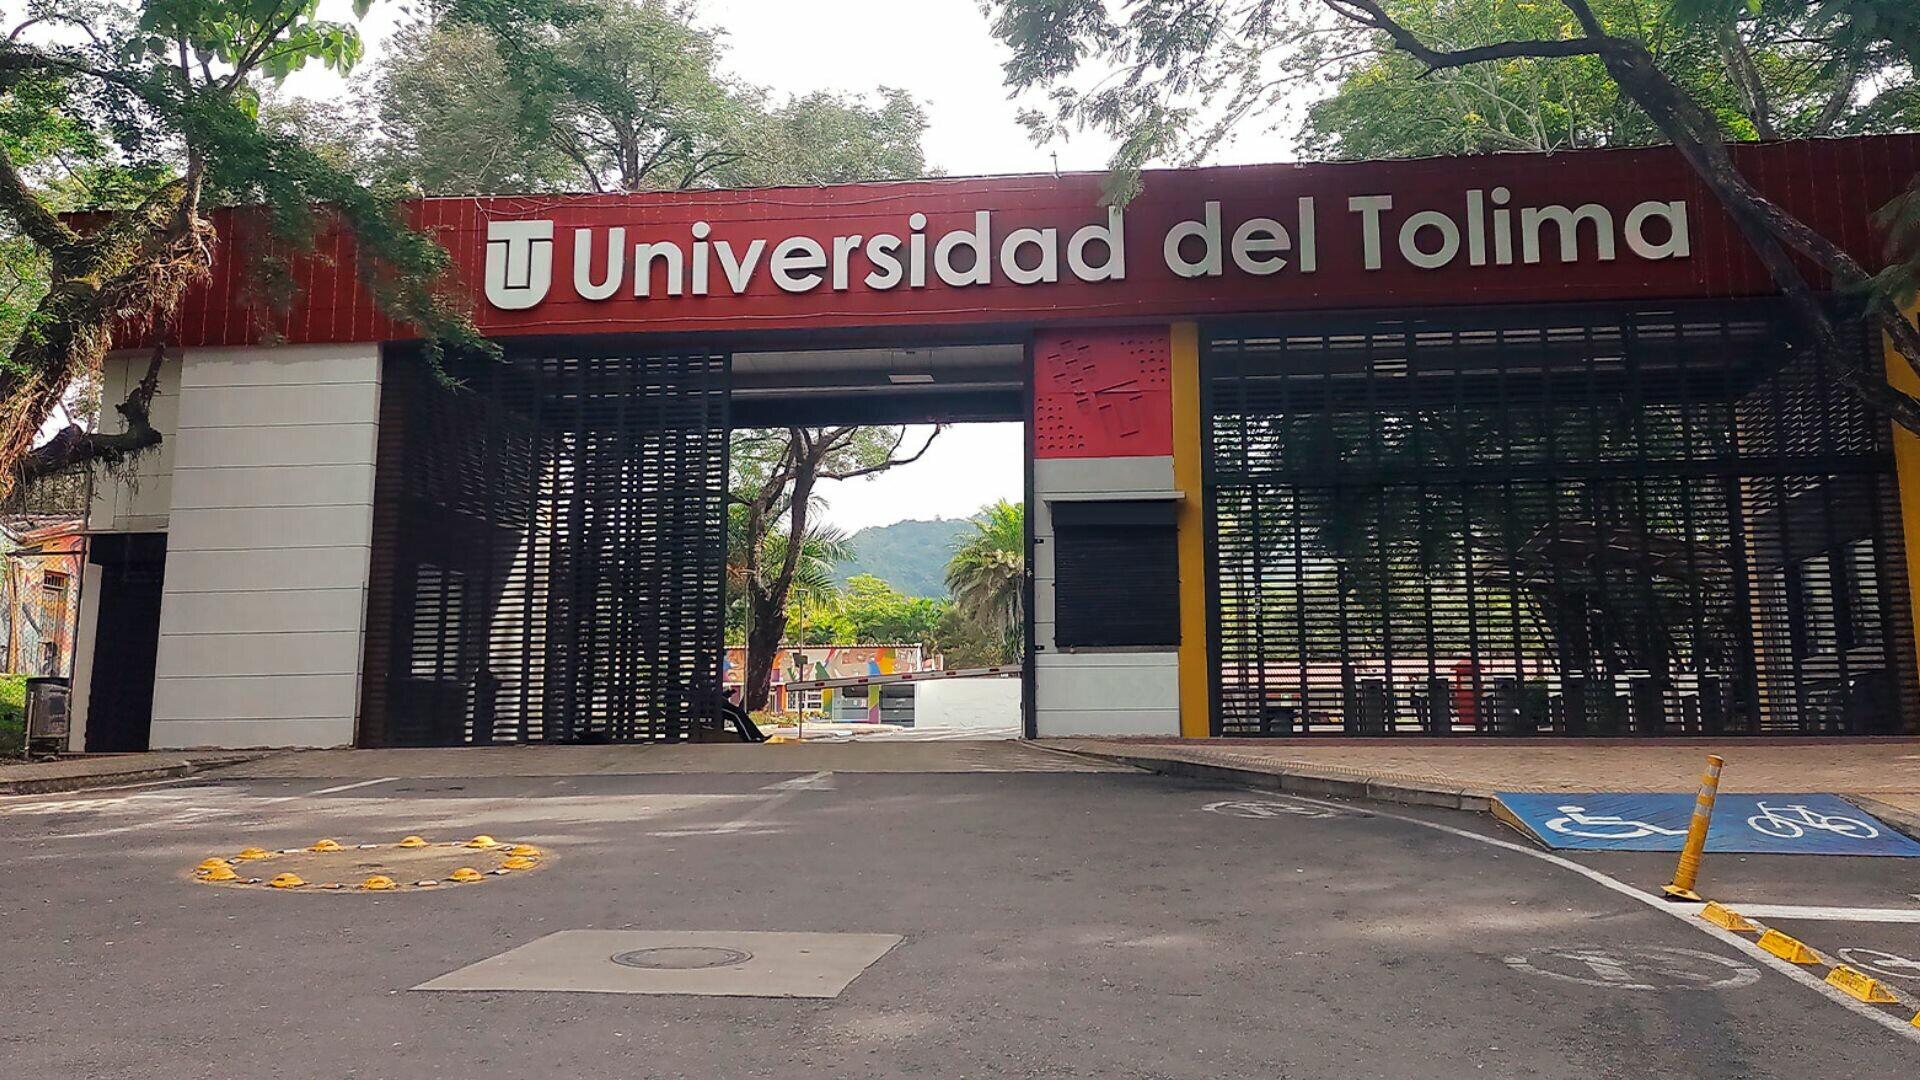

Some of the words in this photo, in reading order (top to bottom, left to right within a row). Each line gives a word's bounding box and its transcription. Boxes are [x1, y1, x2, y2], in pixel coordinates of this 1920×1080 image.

[573, 206, 1126, 301] Universidad
[1163, 196, 1317, 279] del
[1348, 186, 1691, 271] Tolima
